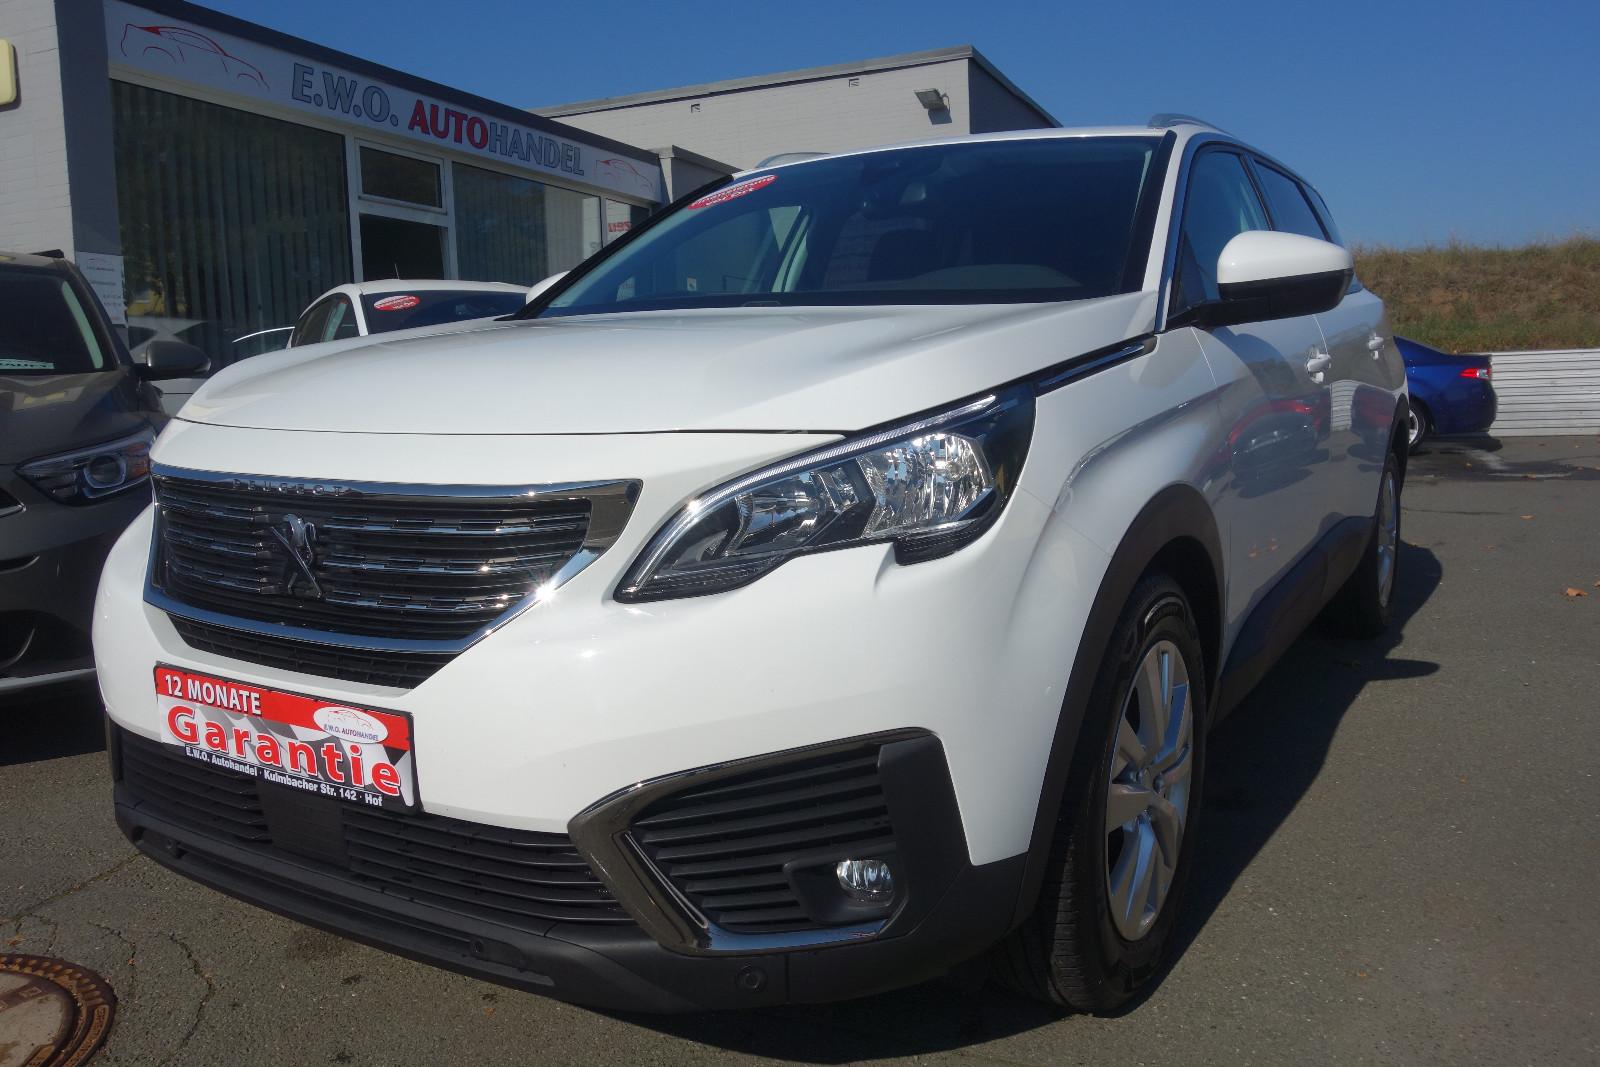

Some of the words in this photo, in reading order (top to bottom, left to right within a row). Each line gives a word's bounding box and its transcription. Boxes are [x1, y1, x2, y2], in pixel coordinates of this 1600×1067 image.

[292, 62, 398, 127] E.W.O.
[408, 99, 585, 176] AUTOHANDEL
[232, 478, 342, 497] PEUGEOT
[165, 674, 183, 697] 12
[187, 678, 262, 715] MONATE
[167, 704, 401, 797] Garantie
[341, 727, 379, 742] AUTOHANDEL
[185, 746, 210, 762] E.W.O.
[211, 754, 258, 777] Autohandel
[263, 768, 319, 792] Kulmbacher
[320, 783, 337, 797] Str.
[339, 787, 357, 801] 142
[364, 793, 383, 807] Hof
